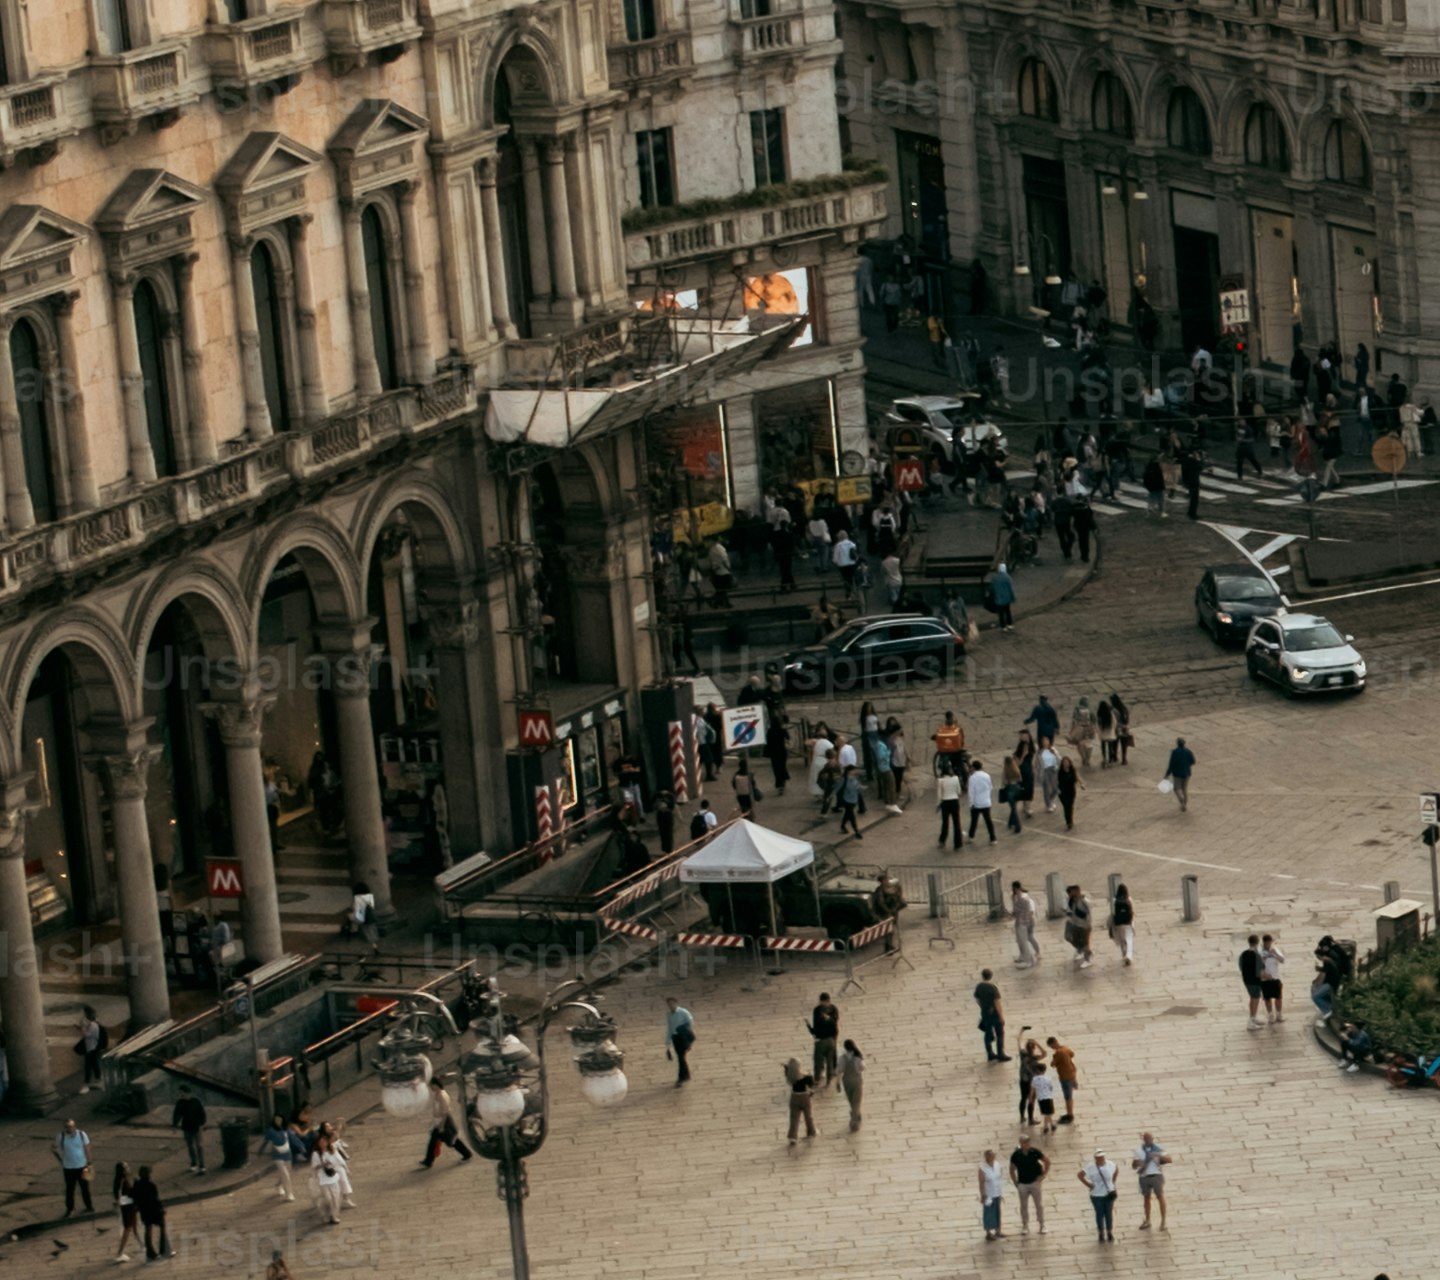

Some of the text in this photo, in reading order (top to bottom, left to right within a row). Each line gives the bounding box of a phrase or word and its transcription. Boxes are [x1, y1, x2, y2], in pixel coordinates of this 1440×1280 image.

[899, 468, 923, 485] M
[523, 717, 549, 739] M
[212, 866, 241, 889] M
